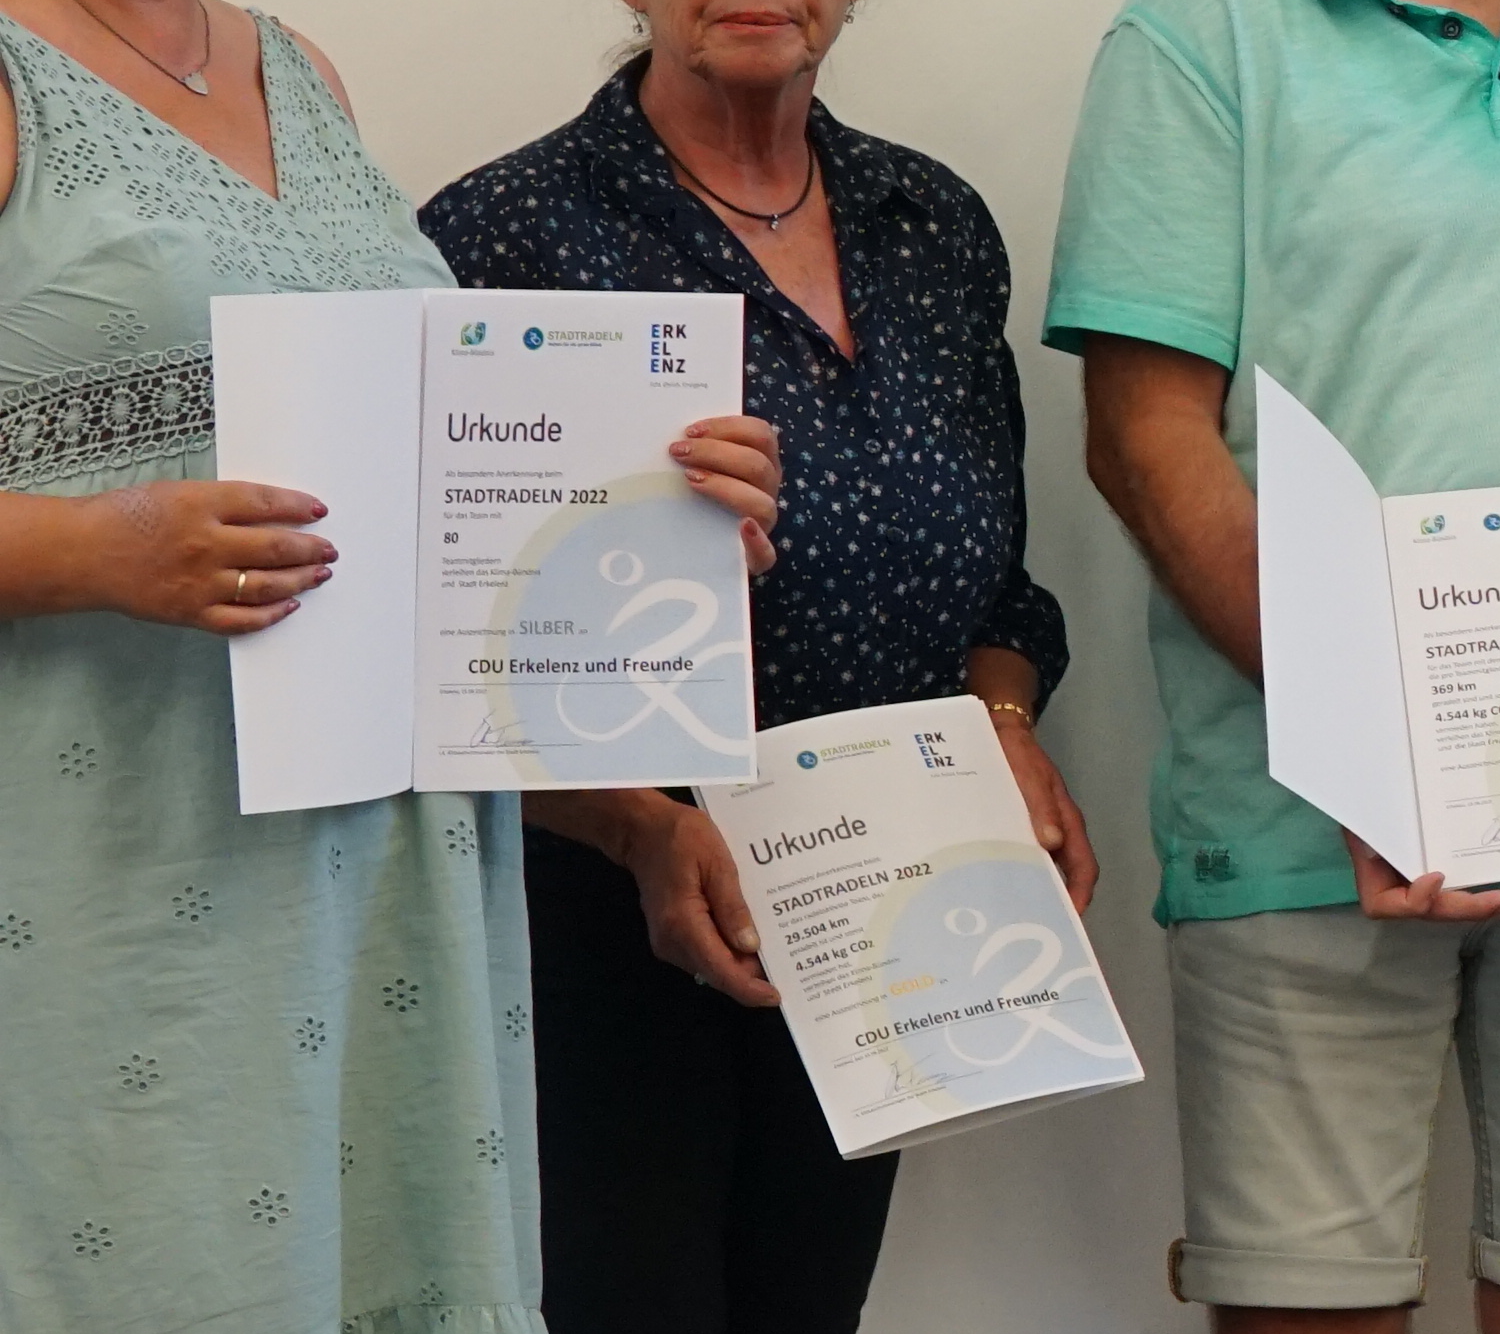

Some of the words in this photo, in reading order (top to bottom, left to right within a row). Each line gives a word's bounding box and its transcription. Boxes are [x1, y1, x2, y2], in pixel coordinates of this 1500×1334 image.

[547, 330, 623, 342] STADTRADELN
[650, 323, 688, 340] ERK
[650, 341, 672, 357] EL
[649, 358, 687, 374] ENZ
[447, 412, 562, 443] Urkunde
[444, 488, 563, 505] STADTRADELN
[569, 489, 608, 505] 2022
[443, 532, 459, 544] 80
[519, 620, 575, 636] SILBER
[468, 658, 504, 674] CDU
[509, 657, 580, 674] Erkelenz
[585, 657, 618, 673] und
[623, 655, 694, 672] Freunde
[1431, 684, 1454, 696] 369
[1457, 682, 1477, 693] km
[1435, 710, 1470, 723] 4.544
[1472, 708, 1488, 719] kg
[914, 731, 947, 745] ERK
[820, 737, 892, 758] STADTRADELN
[919, 745, 939, 757] EL
[923, 755, 956, 769] ENZ
[749, 814, 869, 866] Urkunde
[772, 869, 890, 917] STADTRADELN
[894, 862, 933, 881] 2022
[784, 924, 828, 946] 29.504
[828, 916, 850, 930] km
[795, 951, 831, 972] 4.544
[831, 946, 849, 960] kg
[854, 1025, 891, 1048] CDU
[893, 1008, 962, 1037] Erkelenz
[965, 999, 995, 1018] und
[996, 988, 1061, 1011] Freunde
